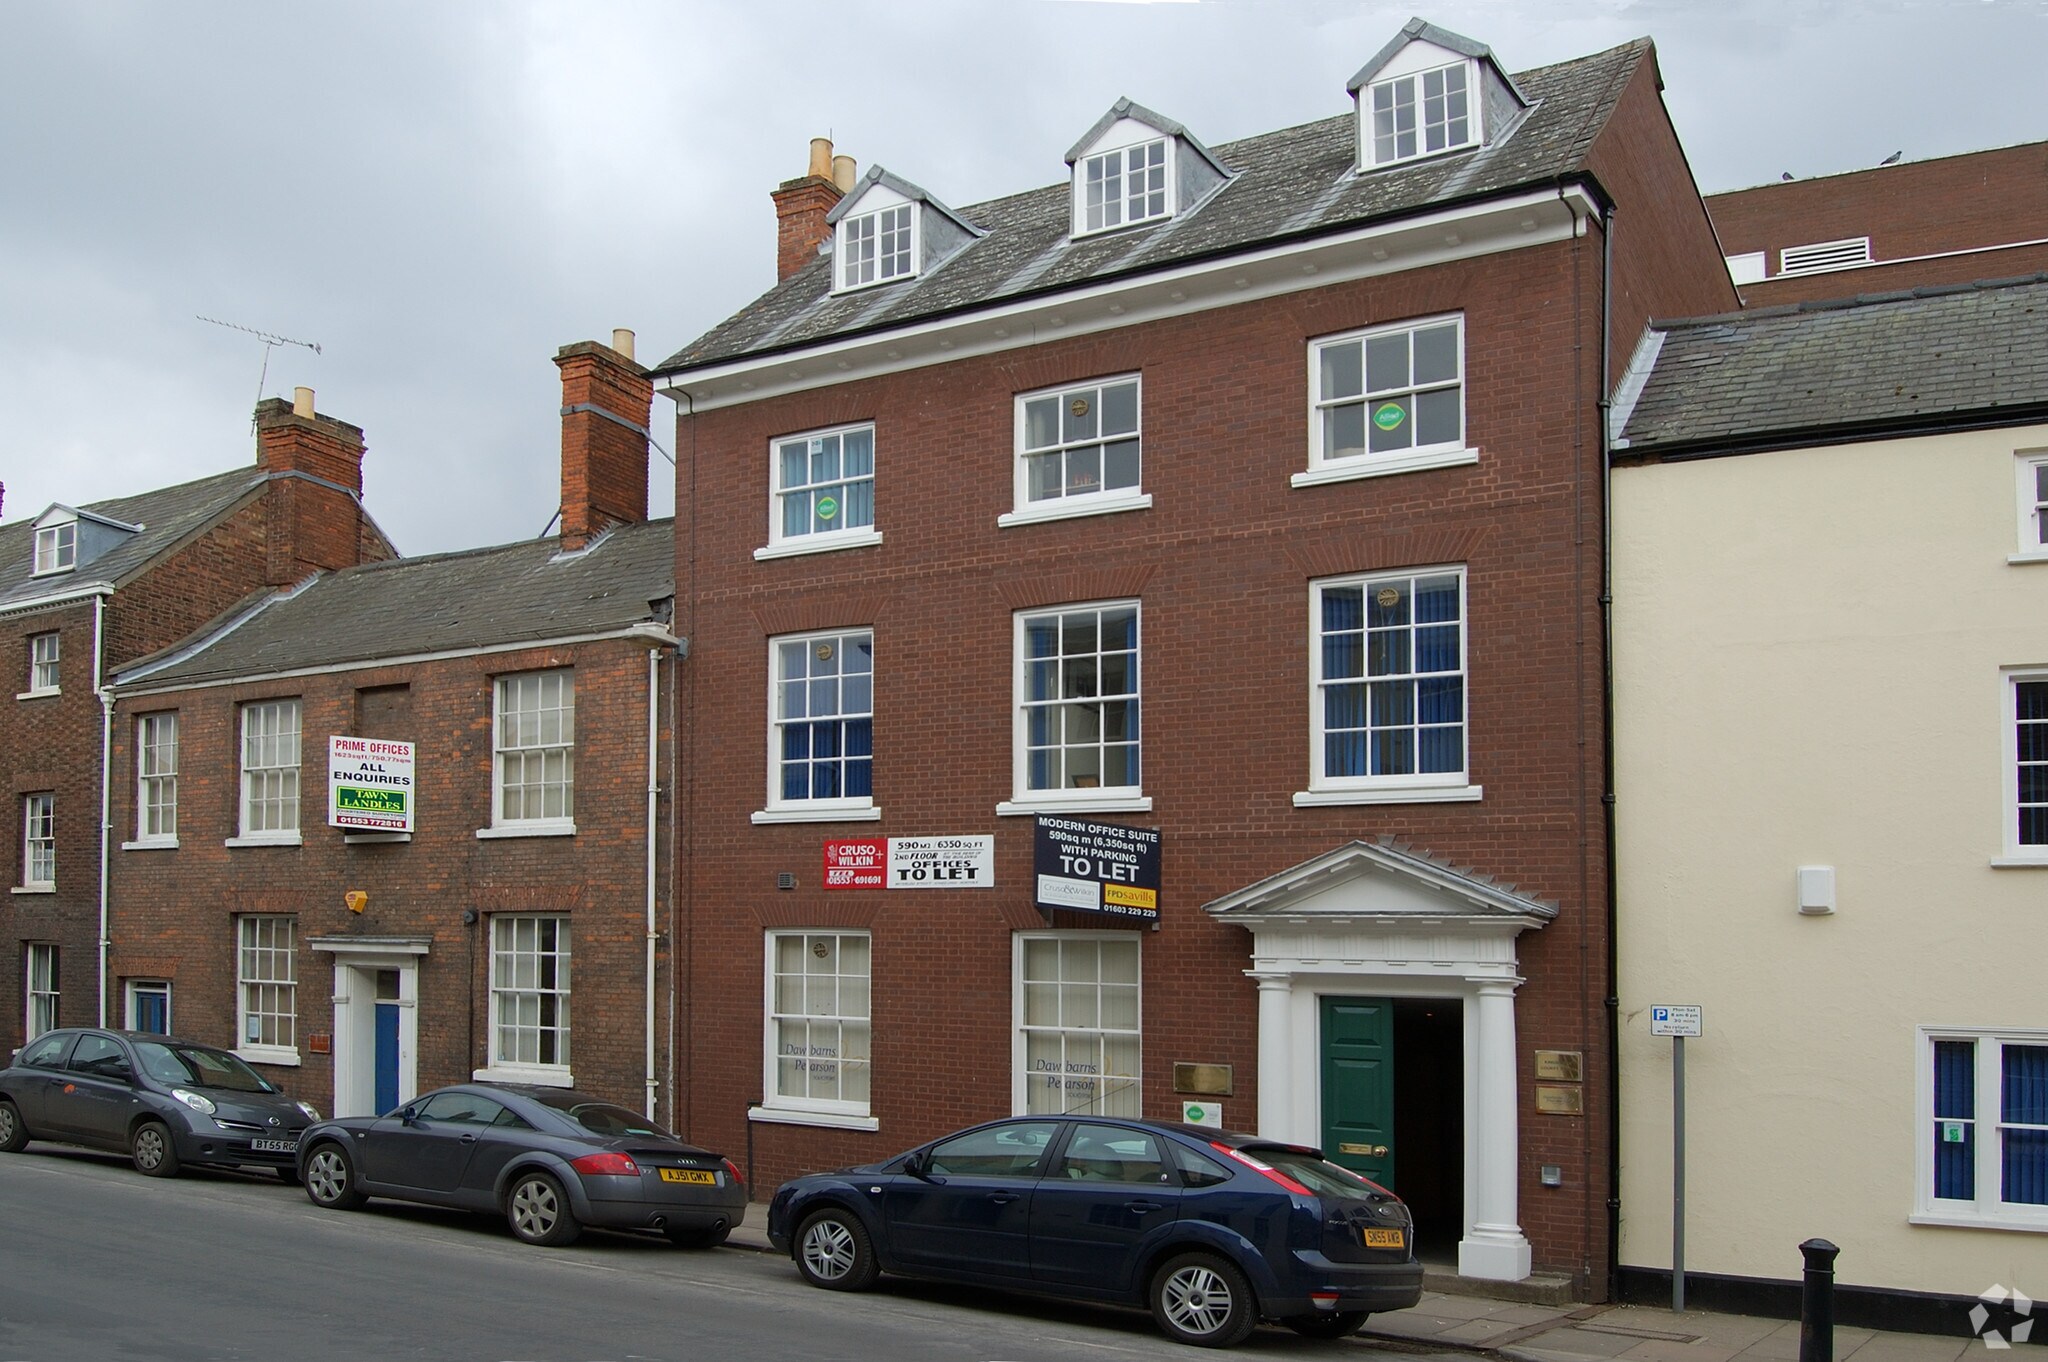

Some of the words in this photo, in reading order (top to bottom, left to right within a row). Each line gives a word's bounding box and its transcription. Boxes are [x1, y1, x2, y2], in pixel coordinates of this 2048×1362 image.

[336, 740, 366, 751] PRIME
[370, 743, 409, 755] OFFICES
[360, 763, 386, 772] ALL
[334, 771, 410, 785] ENQUIRIES
[356, 790, 388, 800] TAWN
[344, 798, 400, 810] LANDLES
[370, 819, 403, 827] 772816
[1039, 817, 1086, 832] MODERN
[1088, 824, 1126, 838] OFFICE
[1128, 831, 1157, 842] SUITE
[937, 840, 961, 848] 6350
[1049, 830, 1079, 844] 590sq
[1094, 837, 1134, 852] (6,350sq
[1136, 843, 1147, 854] ft)
[839, 845, 876, 856] CRUSO
[1061, 844, 1088, 856] WITH
[1091, 848, 1137, 863] PARKING
[839, 856, 873, 866] WILKIN
[910, 852, 938, 860] FLOOR
[912, 860, 971, 868] OFFICES
[1060, 855, 1091, 876] TO
[1098, 861, 1140, 882] LET
[897, 869, 926, 880] TO
[934, 868, 979, 879] LET
[1104, 905, 1126, 914] 01603
[1657, 1010, 1666, 1020] P
[256, 1140, 281, 1150] BT55
[668, 1172, 689, 1181] AJ51
[690, 1173, 709, 1182] GMX
